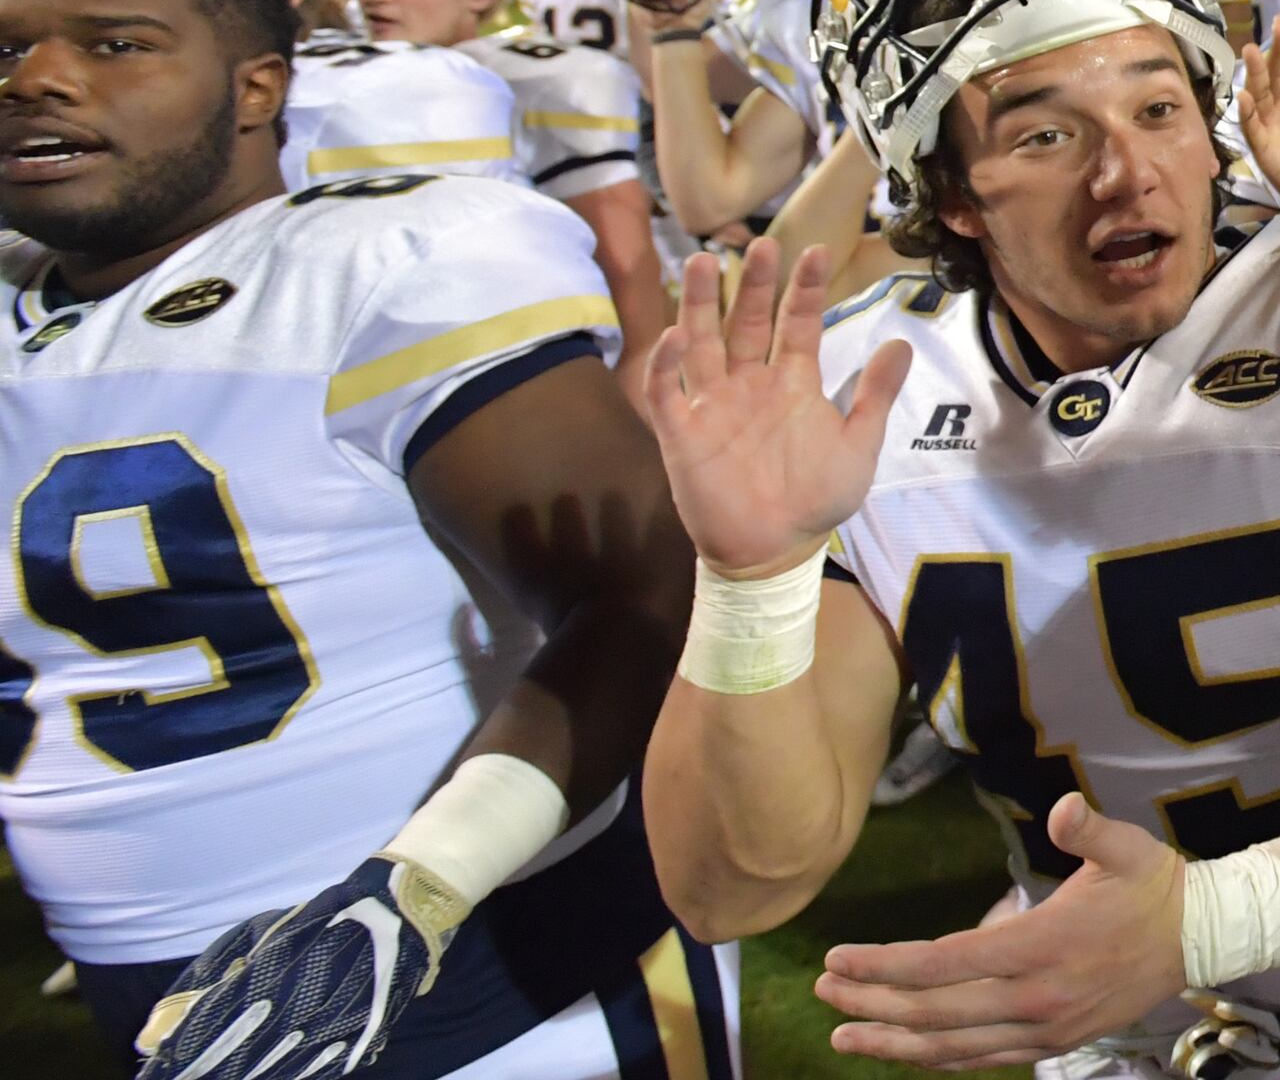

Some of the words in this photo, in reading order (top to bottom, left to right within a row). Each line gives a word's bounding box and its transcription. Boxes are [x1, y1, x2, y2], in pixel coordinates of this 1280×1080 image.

[1055, 392, 1104, 422] GT
[909, 436, 978, 452] RUSSELL
[0, 430, 324, 781] 9
